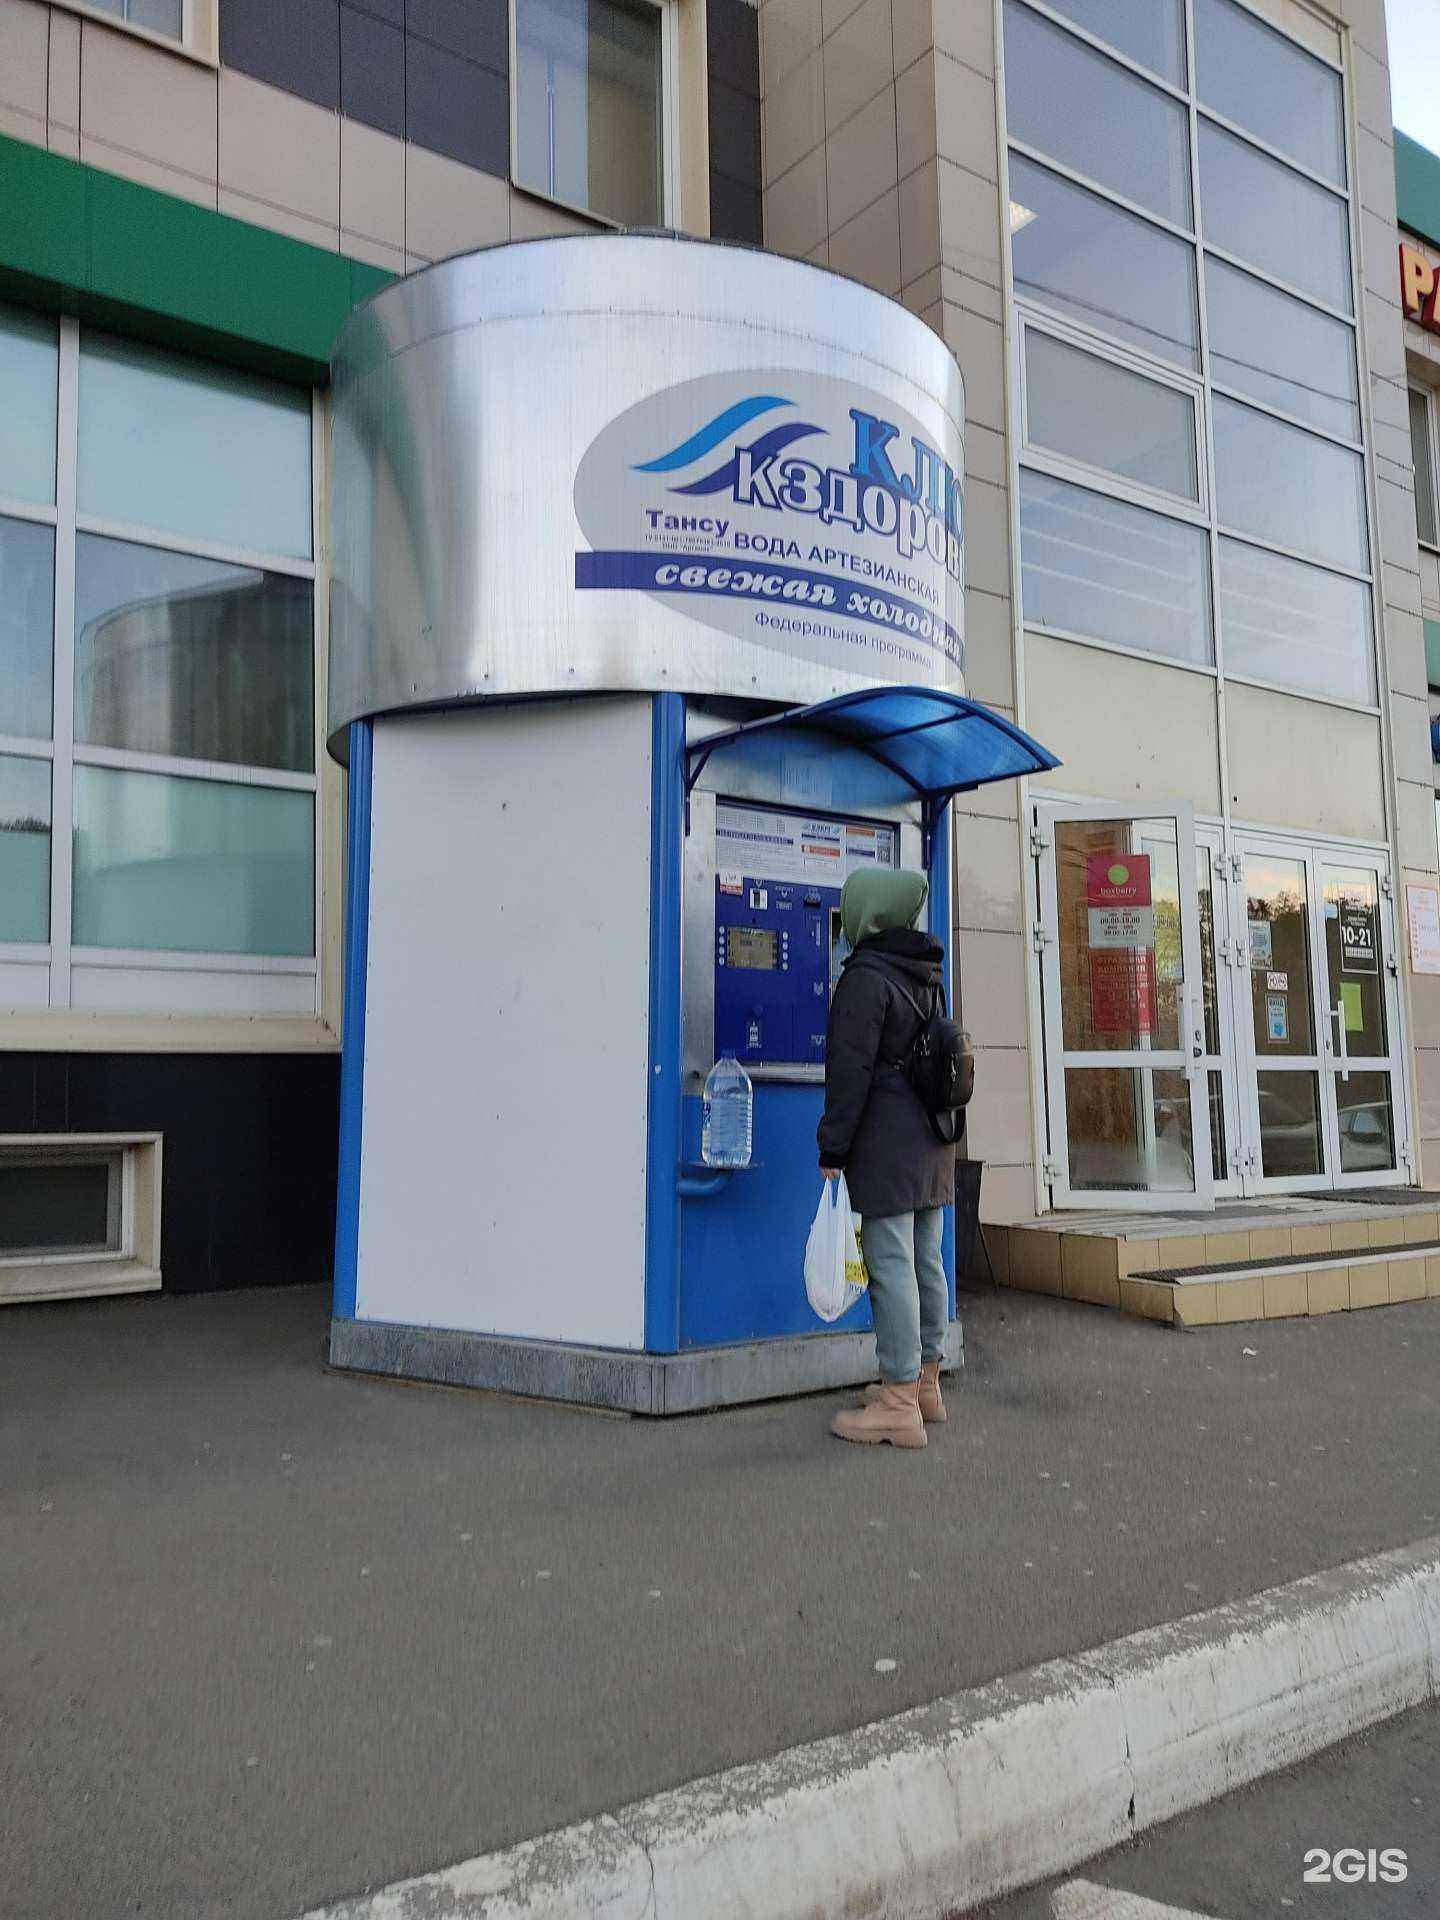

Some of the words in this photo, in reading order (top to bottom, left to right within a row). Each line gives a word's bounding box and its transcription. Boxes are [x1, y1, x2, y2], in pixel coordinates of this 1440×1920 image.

[1399, 243, 1440, 335] Р
[645, 508, 729, 538] Тансу
[655, 563, 837, 606] свежая
[734, 532, 801, 559] ВОДА
[808, 546, 940, 604] АРТЕЗИАНСКАЯ
[1341, 925, 1371, 947] 10-21
